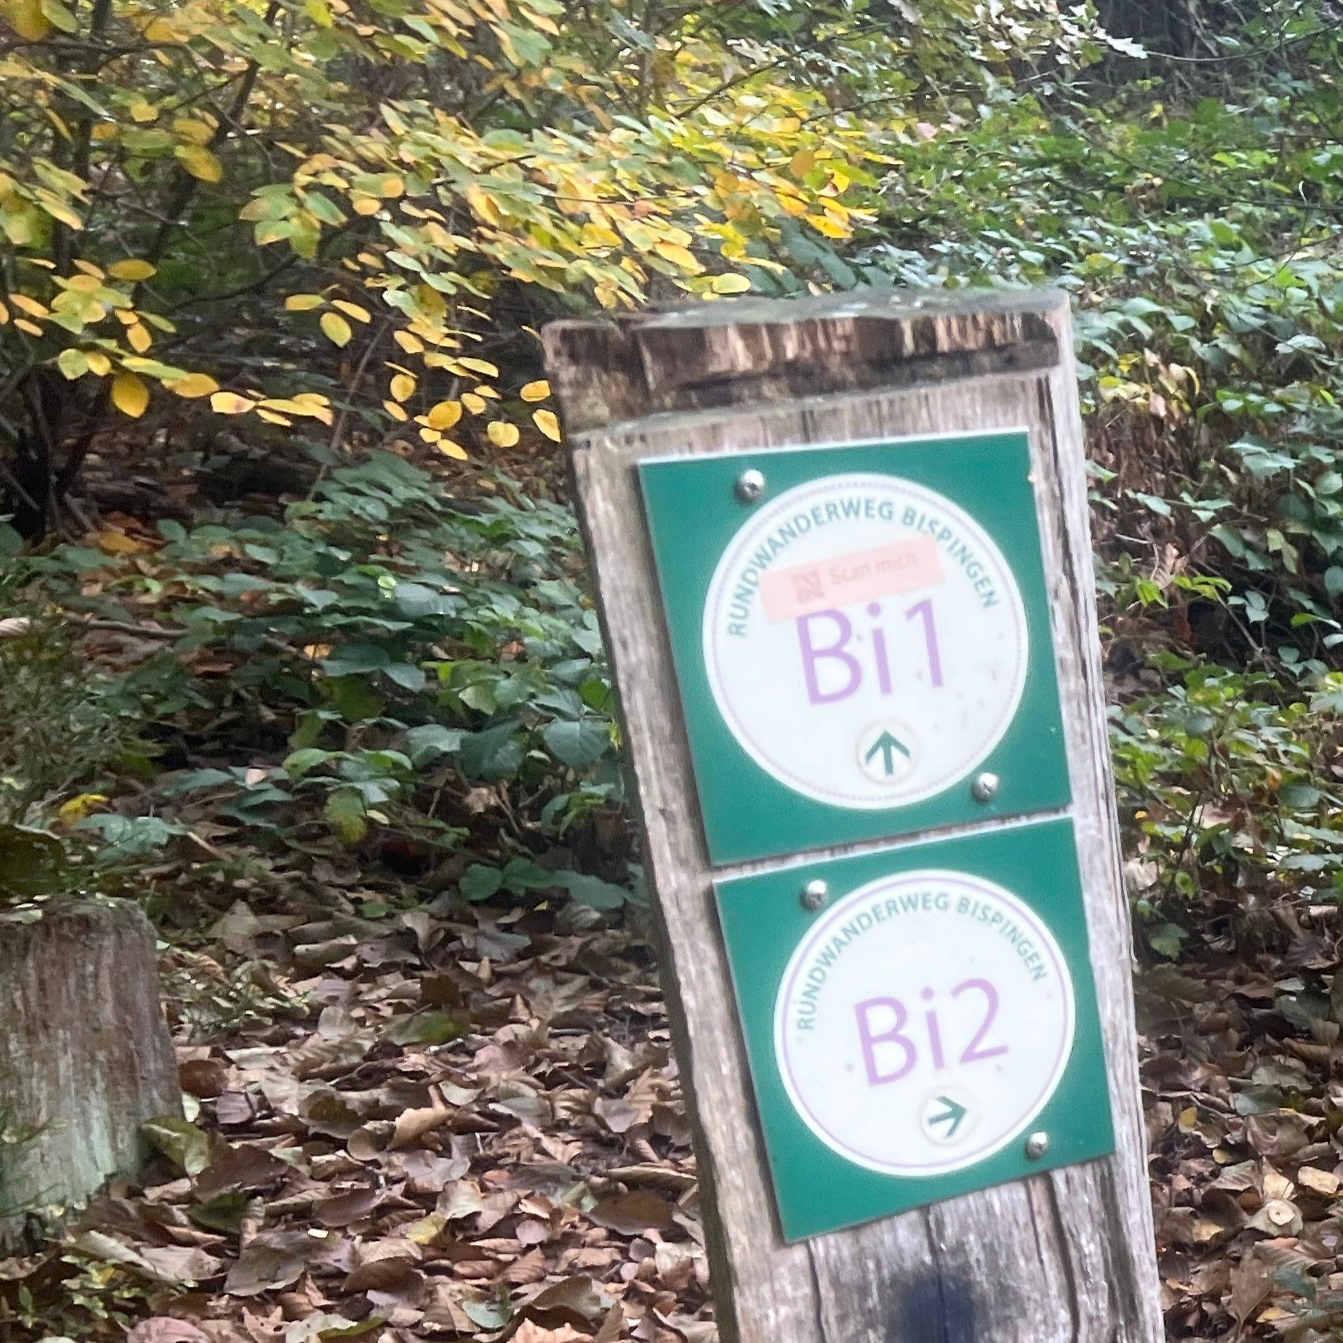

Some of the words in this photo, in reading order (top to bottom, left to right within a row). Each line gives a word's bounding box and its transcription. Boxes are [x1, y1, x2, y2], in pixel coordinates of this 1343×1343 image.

[729, 498, 894, 637] RUNDWANDERWEG
[904, 510, 1000, 609] BISPINGEN
[797, 598, 944, 705] Bi1
[798, 891, 950, 1032] RUNDWANDERWEG
[956, 897, 1049, 982] BISPINGEN
[854, 977, 1010, 1087] Bi2
